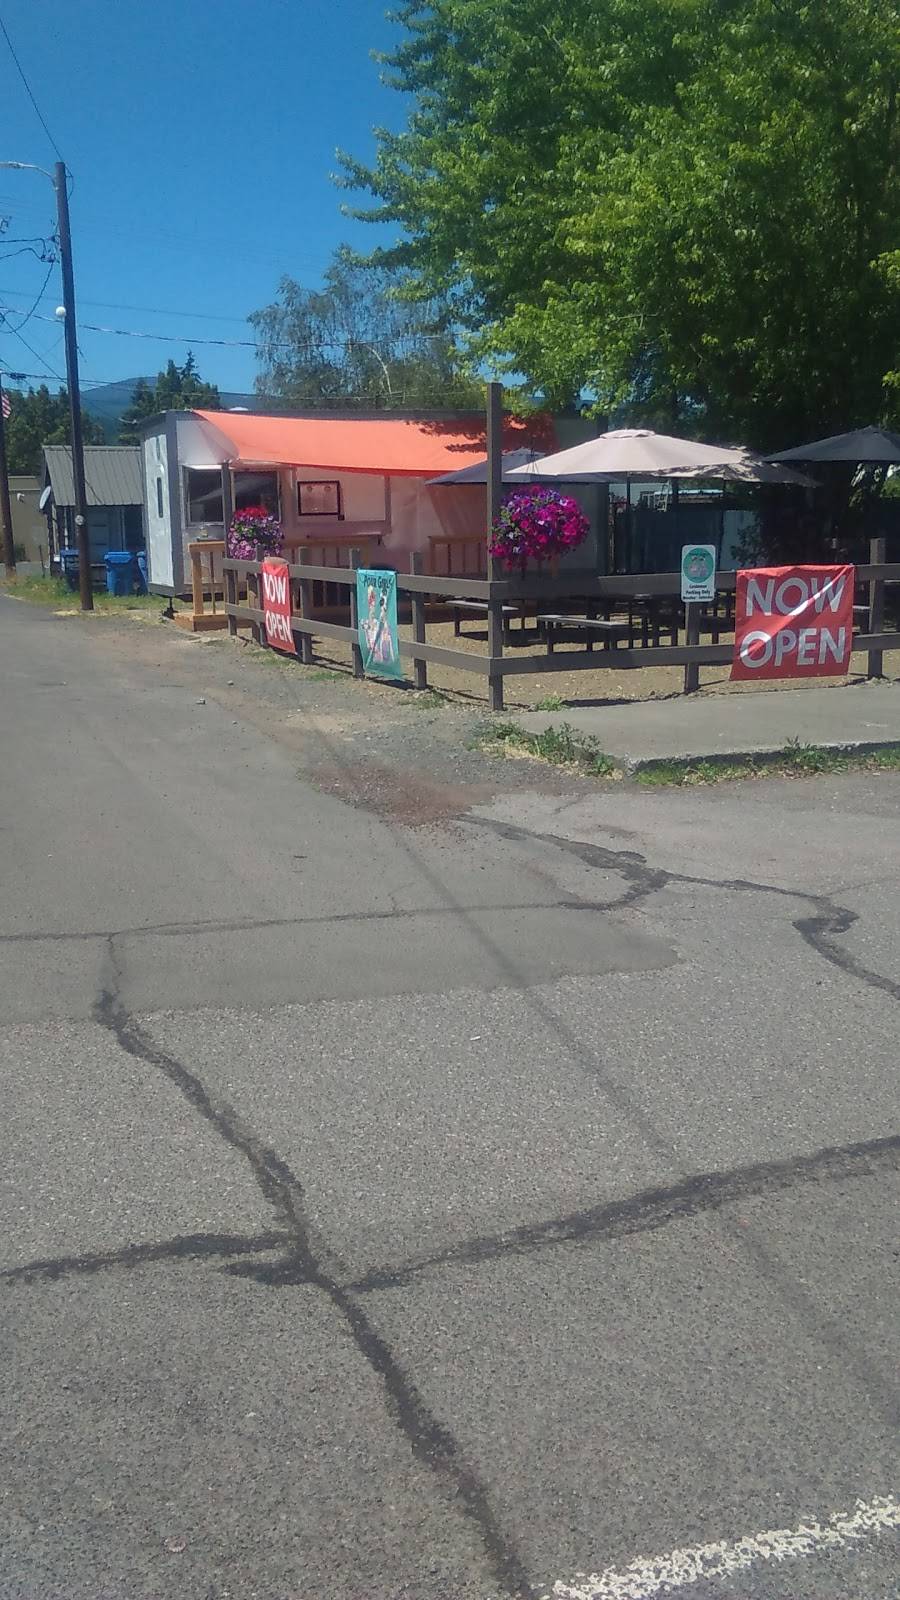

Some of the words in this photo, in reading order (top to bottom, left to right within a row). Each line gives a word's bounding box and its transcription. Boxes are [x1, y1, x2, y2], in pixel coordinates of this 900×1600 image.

[263, 573, 285, 604] NOW
[746, 575, 846, 616] NOW
[266, 610, 292, 642] OPEN
[740, 627, 845, 668] OPEN
